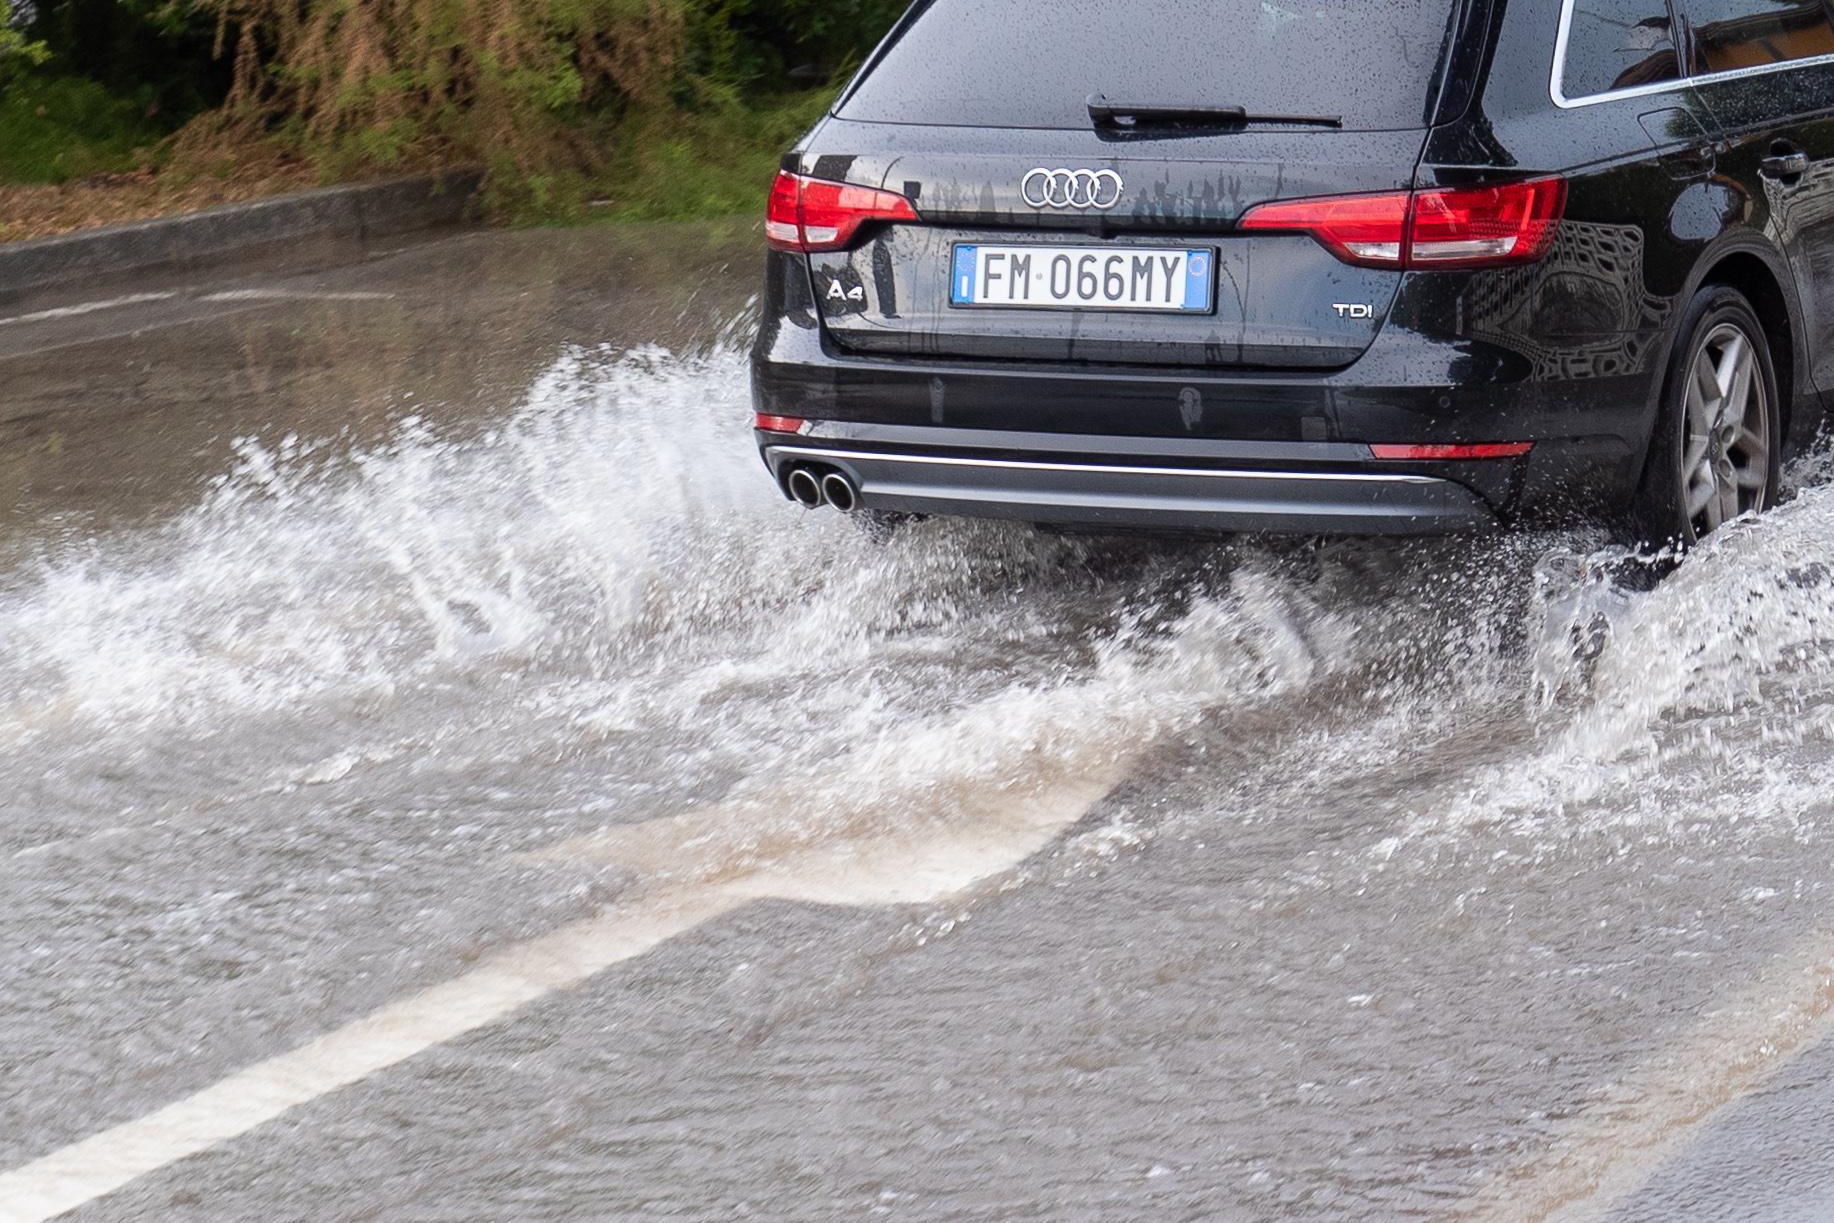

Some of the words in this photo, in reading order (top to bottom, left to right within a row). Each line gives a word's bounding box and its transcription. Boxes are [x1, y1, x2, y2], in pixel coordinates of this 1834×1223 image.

[983, 253, 1031, 300] FM
[1050, 254, 1180, 302] 066MY
[826, 279, 863, 302] A4
[1332, 303, 1373, 318] TDI
